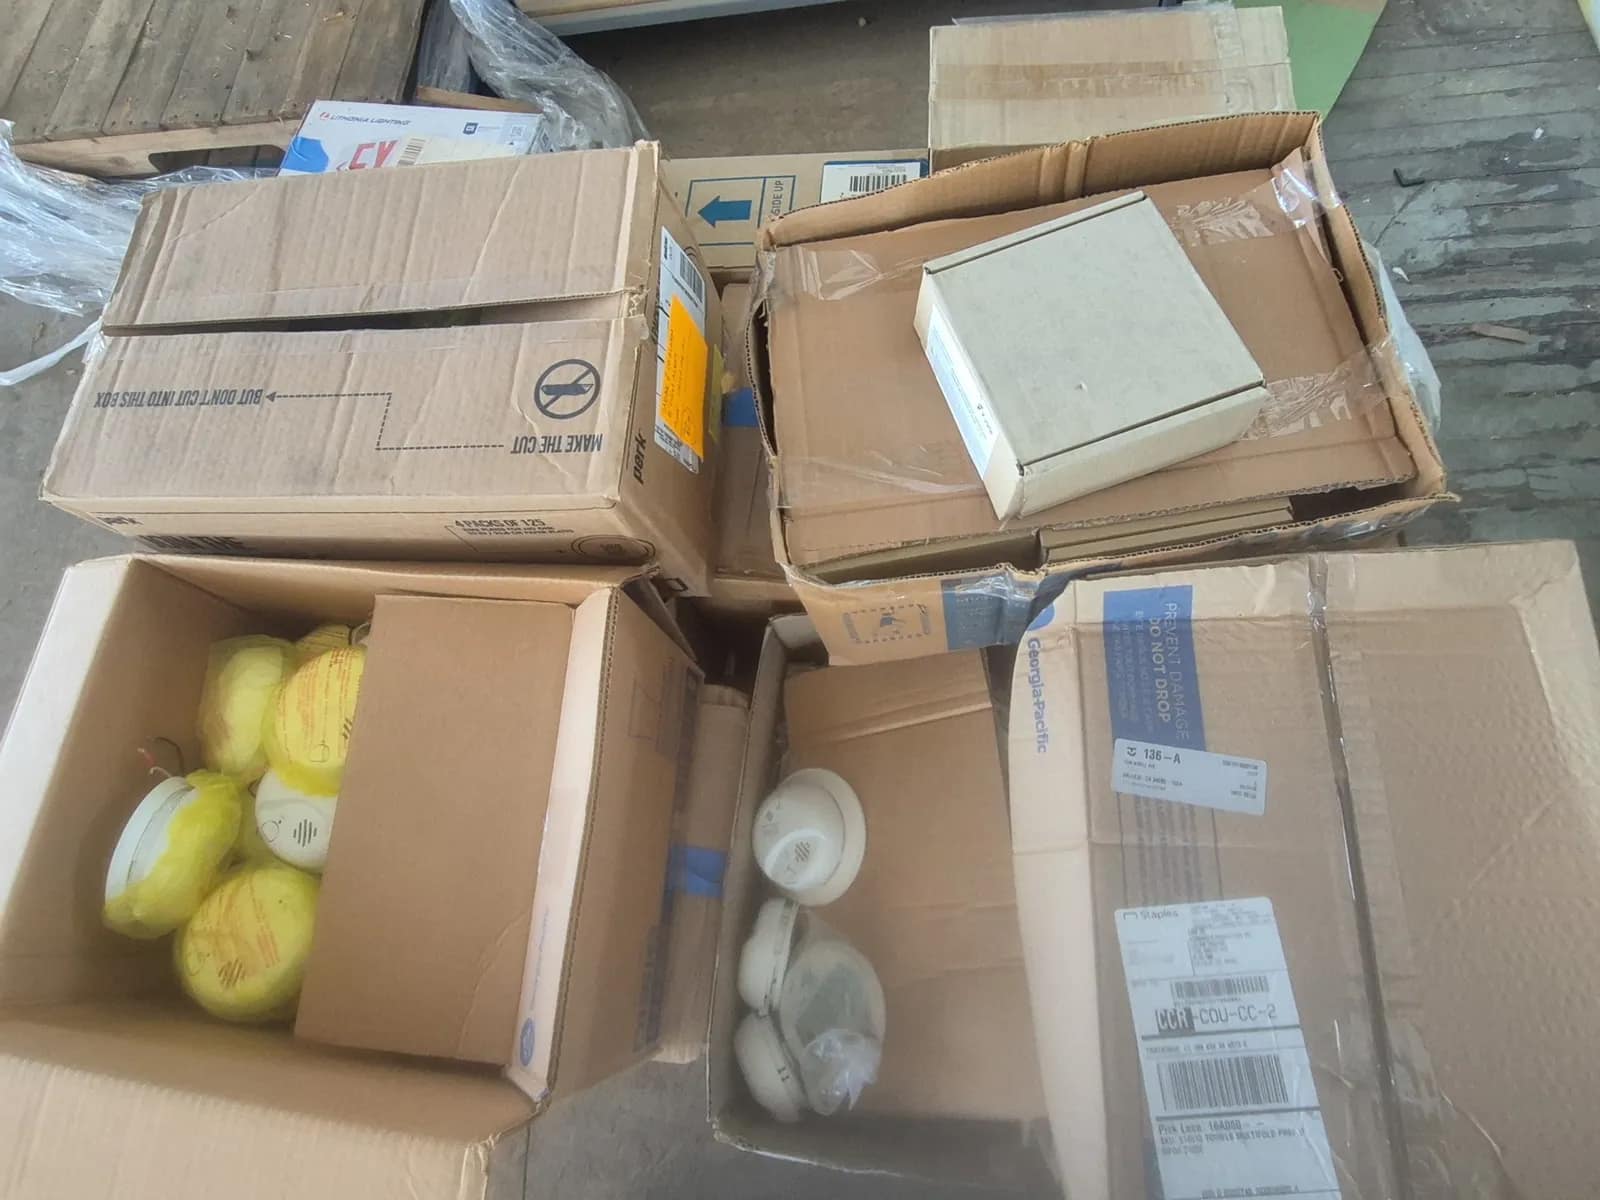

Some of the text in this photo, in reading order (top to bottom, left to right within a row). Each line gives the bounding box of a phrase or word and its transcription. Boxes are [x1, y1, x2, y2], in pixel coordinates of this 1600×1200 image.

[773, 180, 784, 192] UP
[93, 388, 264, 408] BUT DON'T CUT INTO THIS BOX
[510, 433, 603, 454] MAKE THE CUT
[633, 432, 648, 485] perk
[463, 519, 501, 528] PACKS
[503, 519, 519, 528] OF
[520, 518, 546, 527] 125
[1150, 642, 1166, 674] NOT
[1163, 602, 1190, 741] PREVENT DAMAGE
[1027, 637, 1049, 753] Georgia-Pacific
[1154, 679, 1171, 723] DROP
